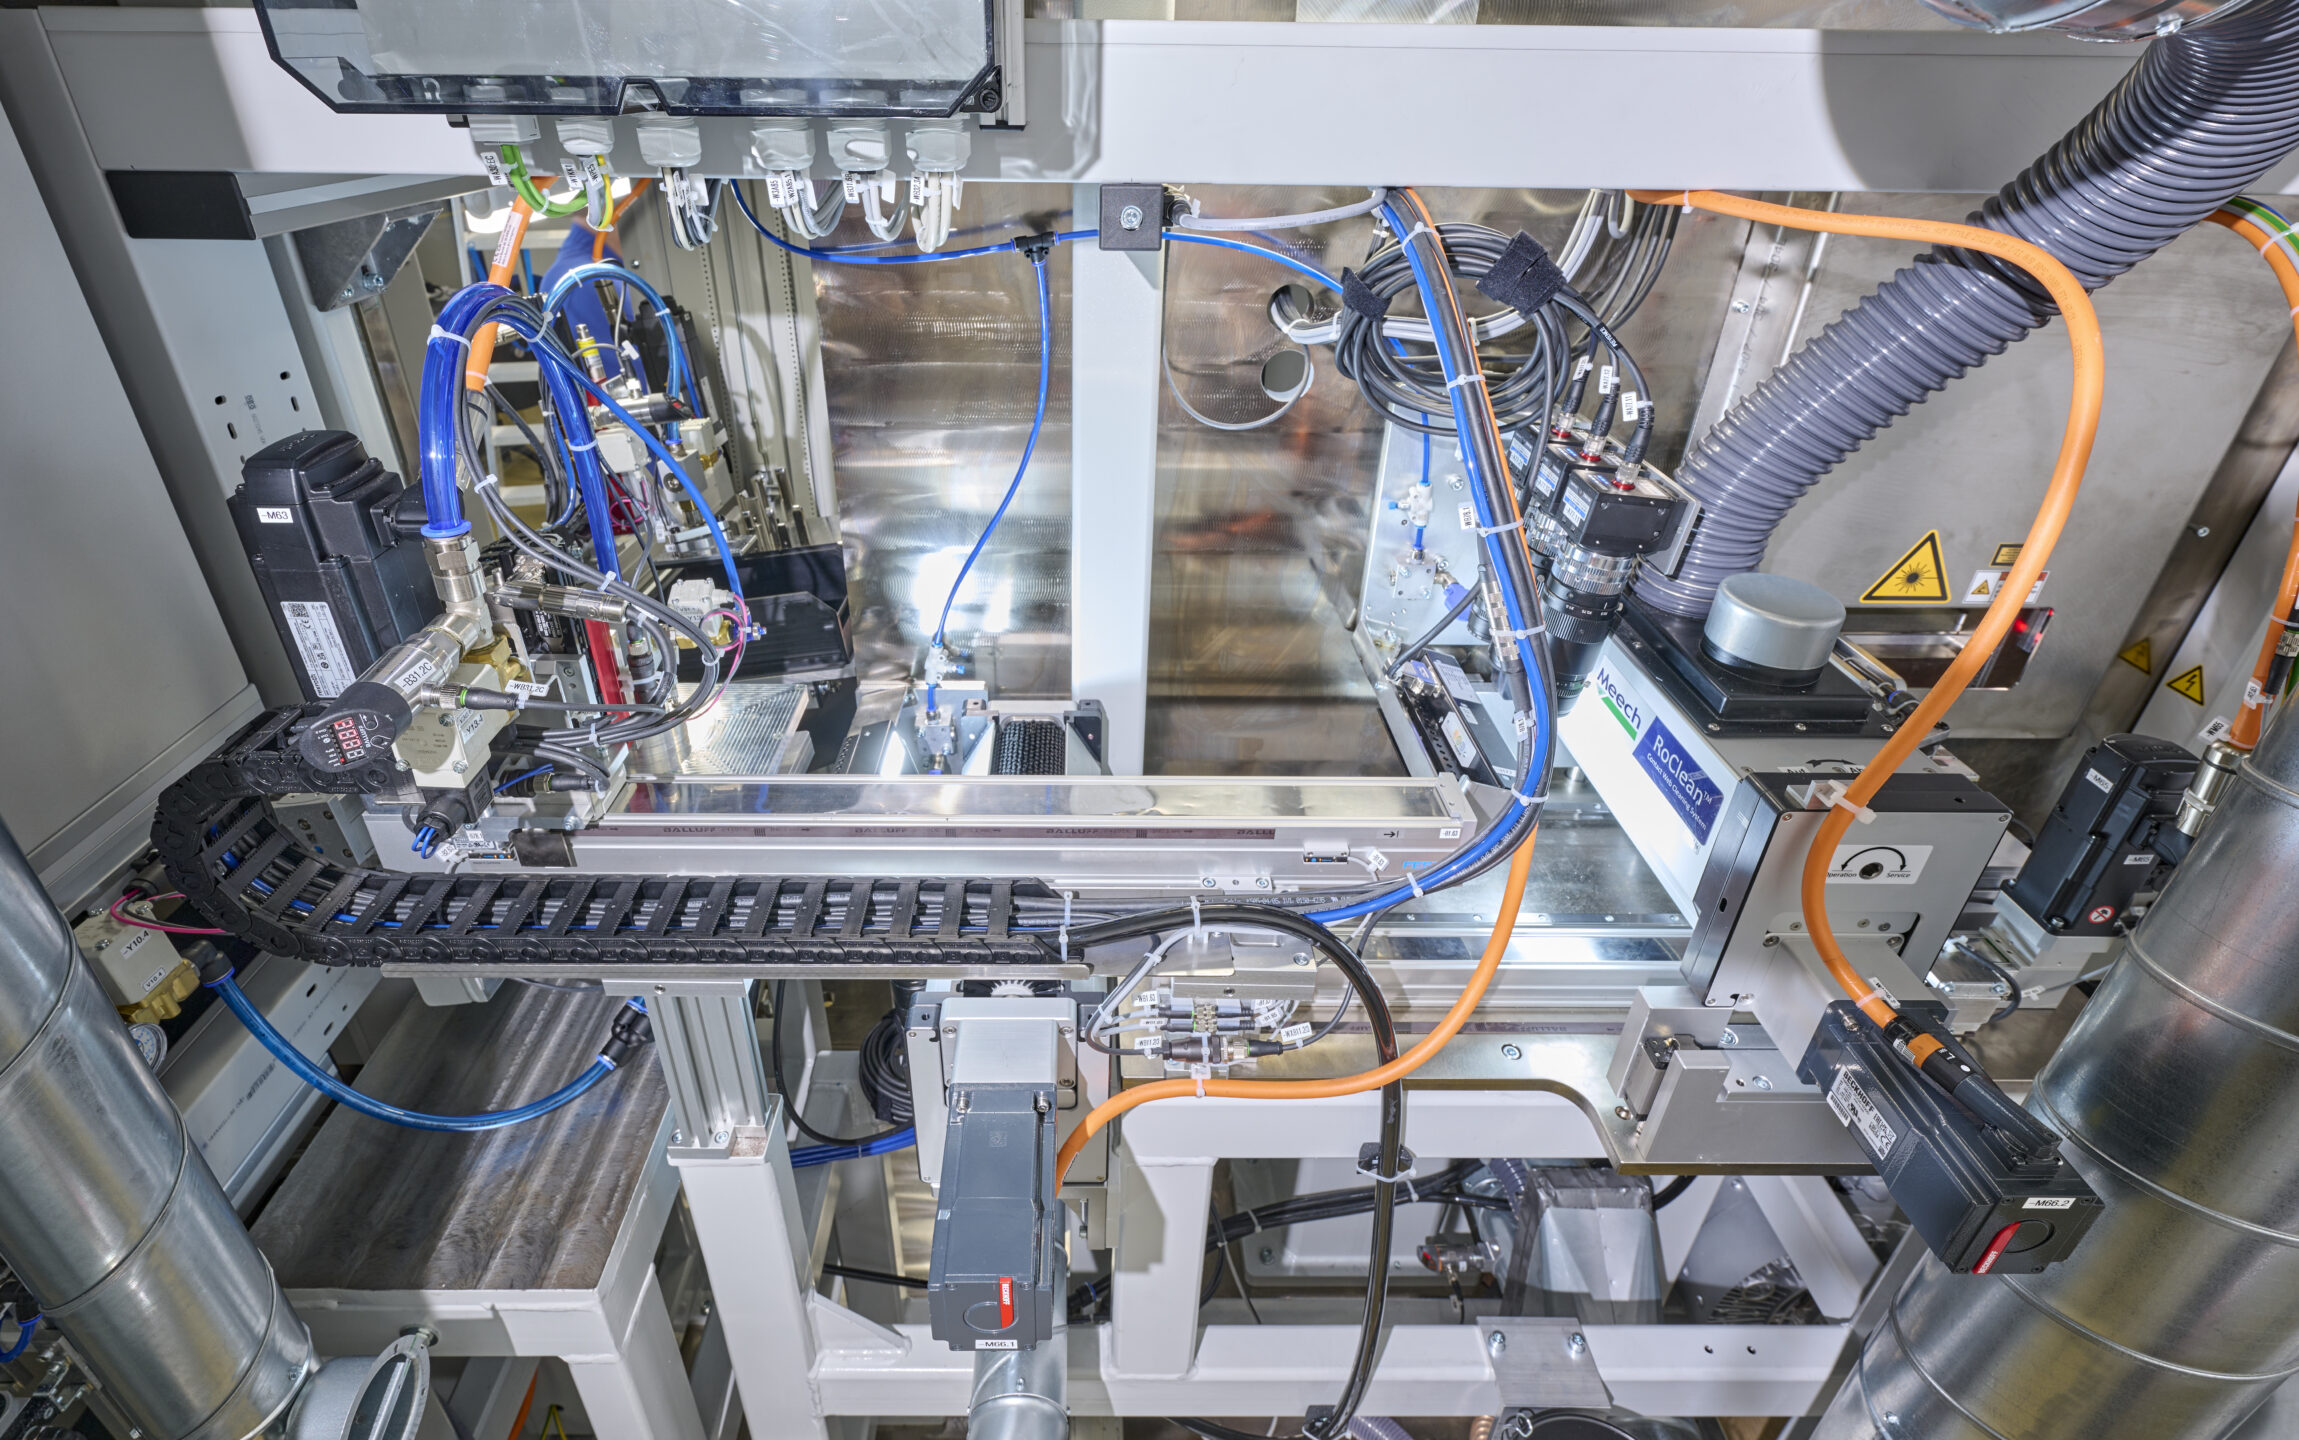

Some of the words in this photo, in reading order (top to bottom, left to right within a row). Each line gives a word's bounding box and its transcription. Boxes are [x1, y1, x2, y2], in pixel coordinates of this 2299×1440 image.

[1600, 326, 1618, 347] KEYENCE
[261, 511, 290, 521] -M63
[402, 662, 434, 688] -B31.2C
[1597, 667, 1642, 730] Meech
[1647, 753, 1663, 776] Contact
[1662, 772, 1673, 789] Web
[1672, 784, 1691, 812] Cleaning
[1689, 806, 1707, 831] System
[123, 929, 150, 956] -Y10.4
[1843, 1070, 1875, 1113] BECKHOFF
[2029, 1199, 2070, 1207] -M66.2
[1977, 1250, 1999, 1274] BECKHOFF
[1001, 1283, 1011, 1306] BECKHOFF
